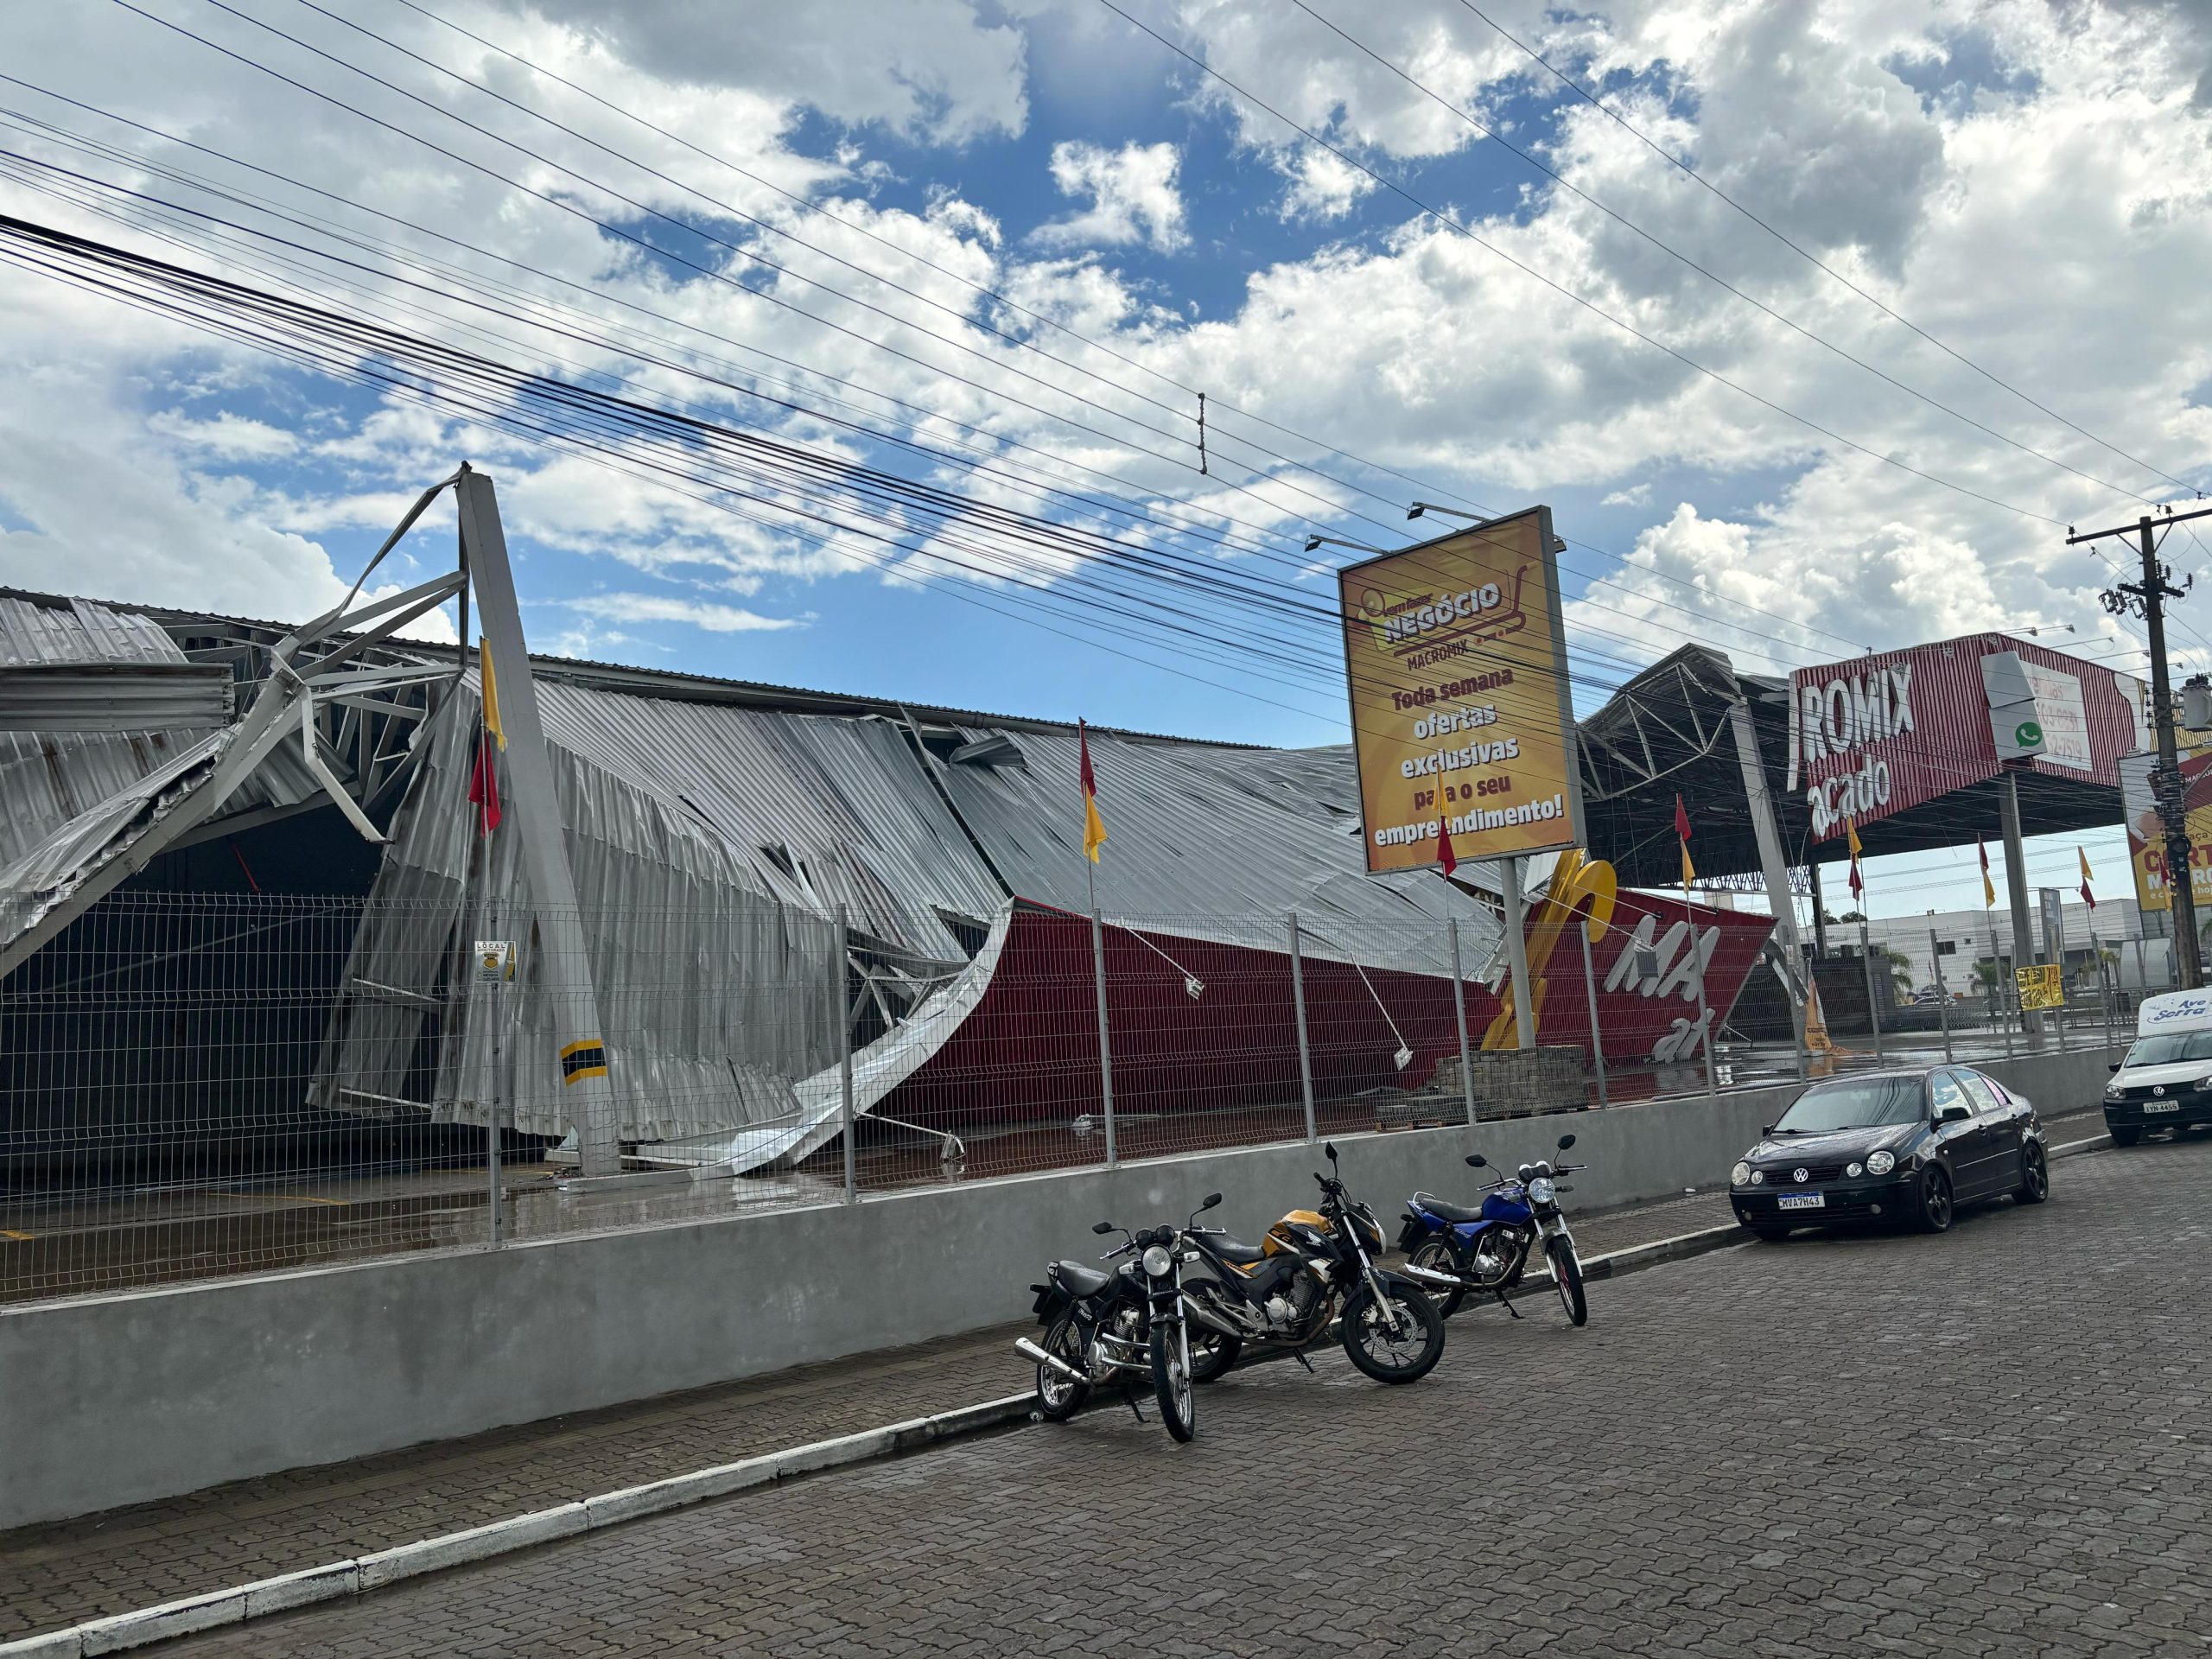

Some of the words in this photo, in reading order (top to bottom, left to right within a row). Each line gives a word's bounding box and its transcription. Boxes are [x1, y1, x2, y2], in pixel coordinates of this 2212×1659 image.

[1384, 582, 1502, 645] NEGÓCIO
[1407, 639, 1469, 671] MACROMIX
[1391, 686, 1437, 710] Toda
[1440, 668, 1515, 701] semana
[1414, 704, 1497, 740] ofertas
[1802, 663, 1915, 763] ROMIX
[1401, 738, 1521, 779] exclusivas
[1414, 785, 1456, 810] paa
[1460, 782, 1473, 800] o
[1477, 776, 1512, 797] seu
[1807, 753, 1891, 837] acado
[1374, 793, 1564, 847] emprendimento!
[2185, 831, 2209, 842] aça
